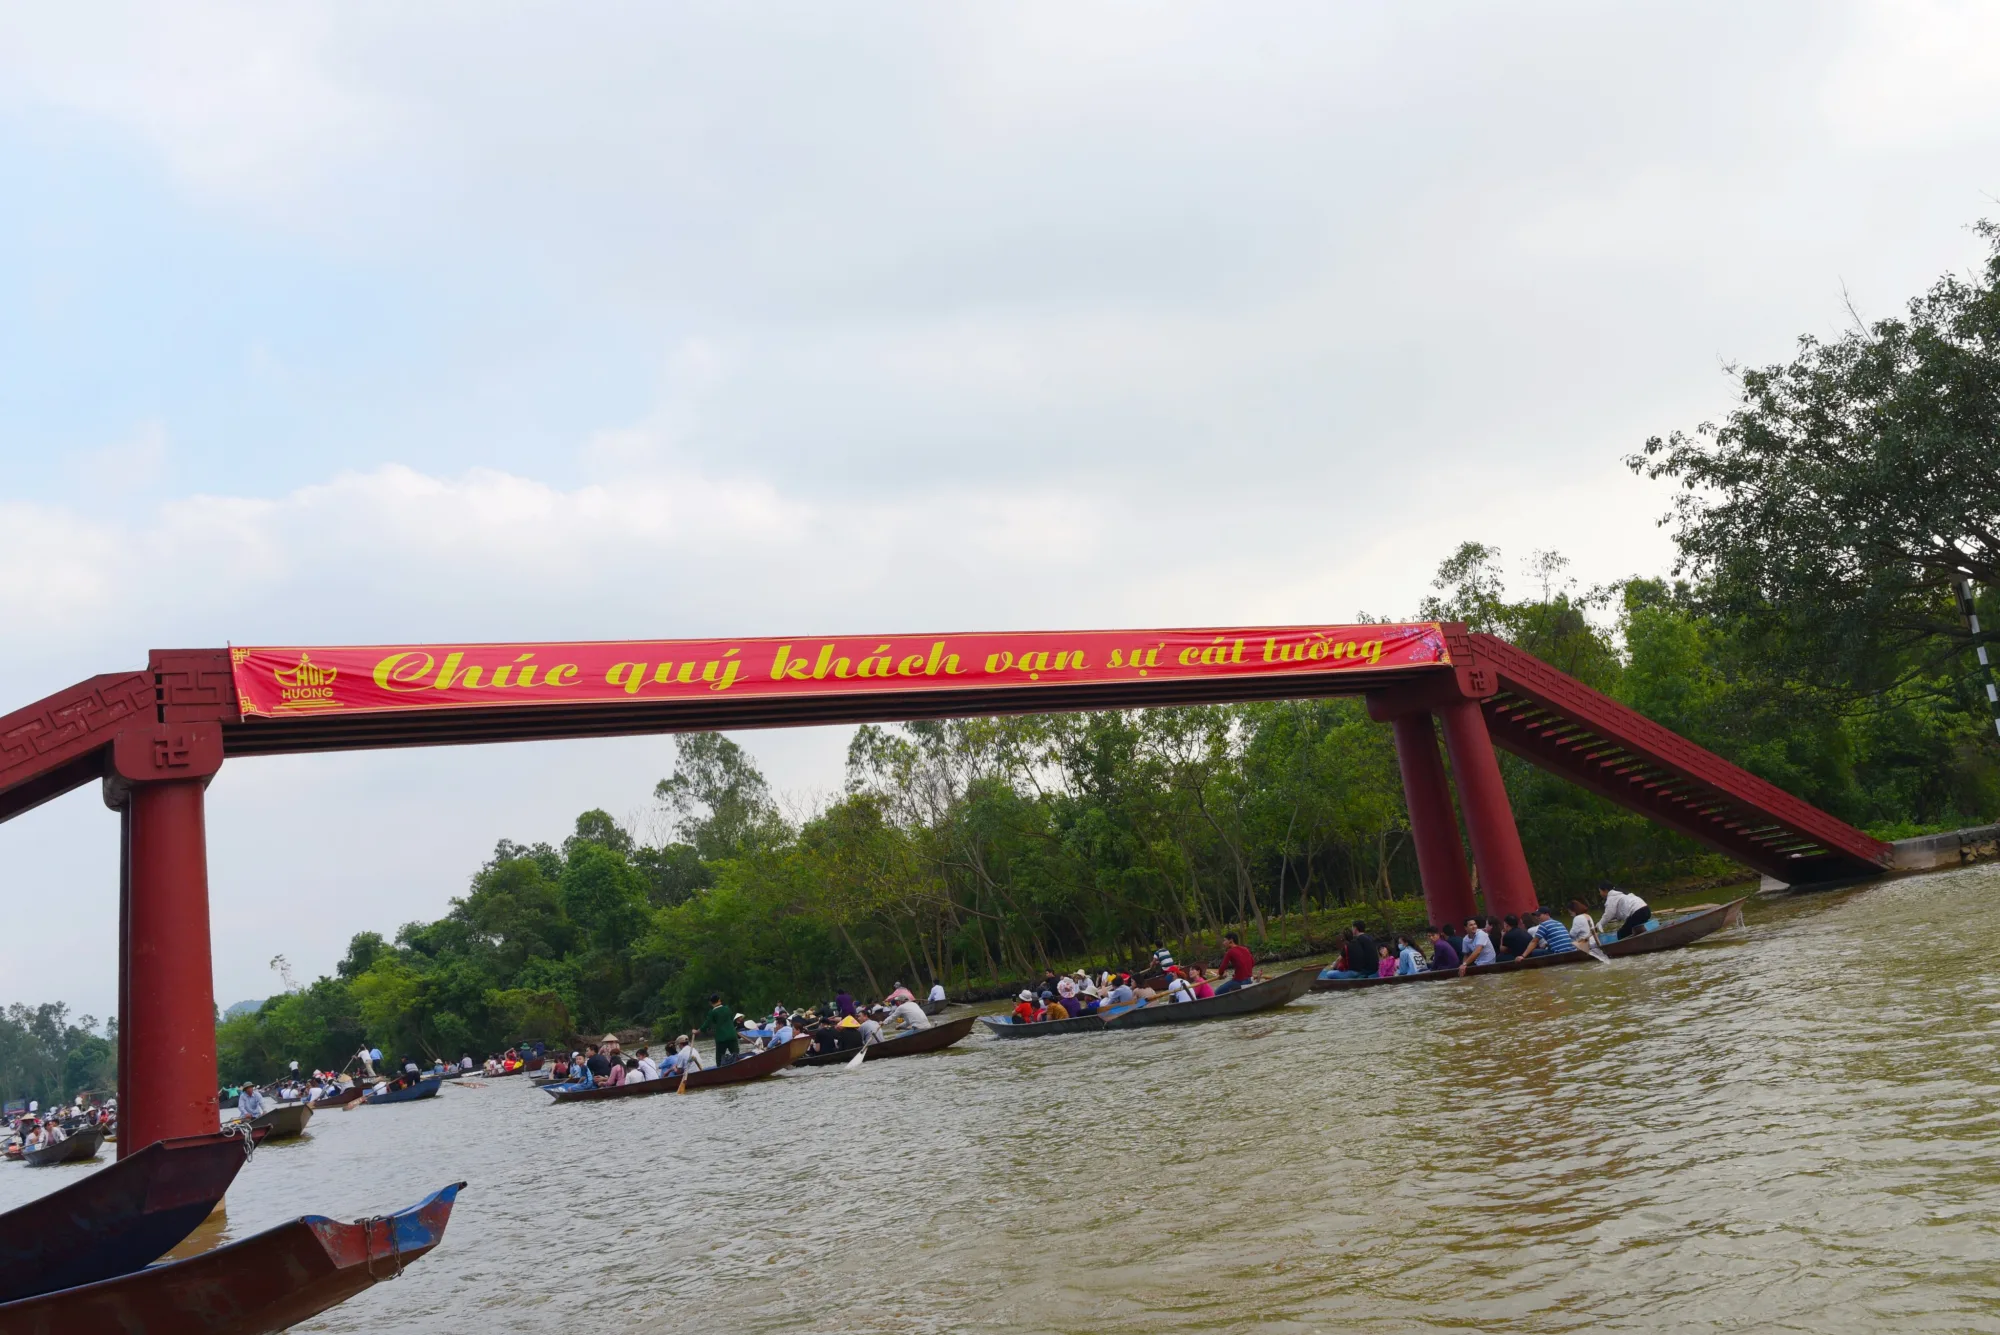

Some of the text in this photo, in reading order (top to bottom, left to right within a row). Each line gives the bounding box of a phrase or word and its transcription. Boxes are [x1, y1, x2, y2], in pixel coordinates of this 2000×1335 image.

[372, 632, 1389, 695] Chúc quý khách vạn sự cát tường
